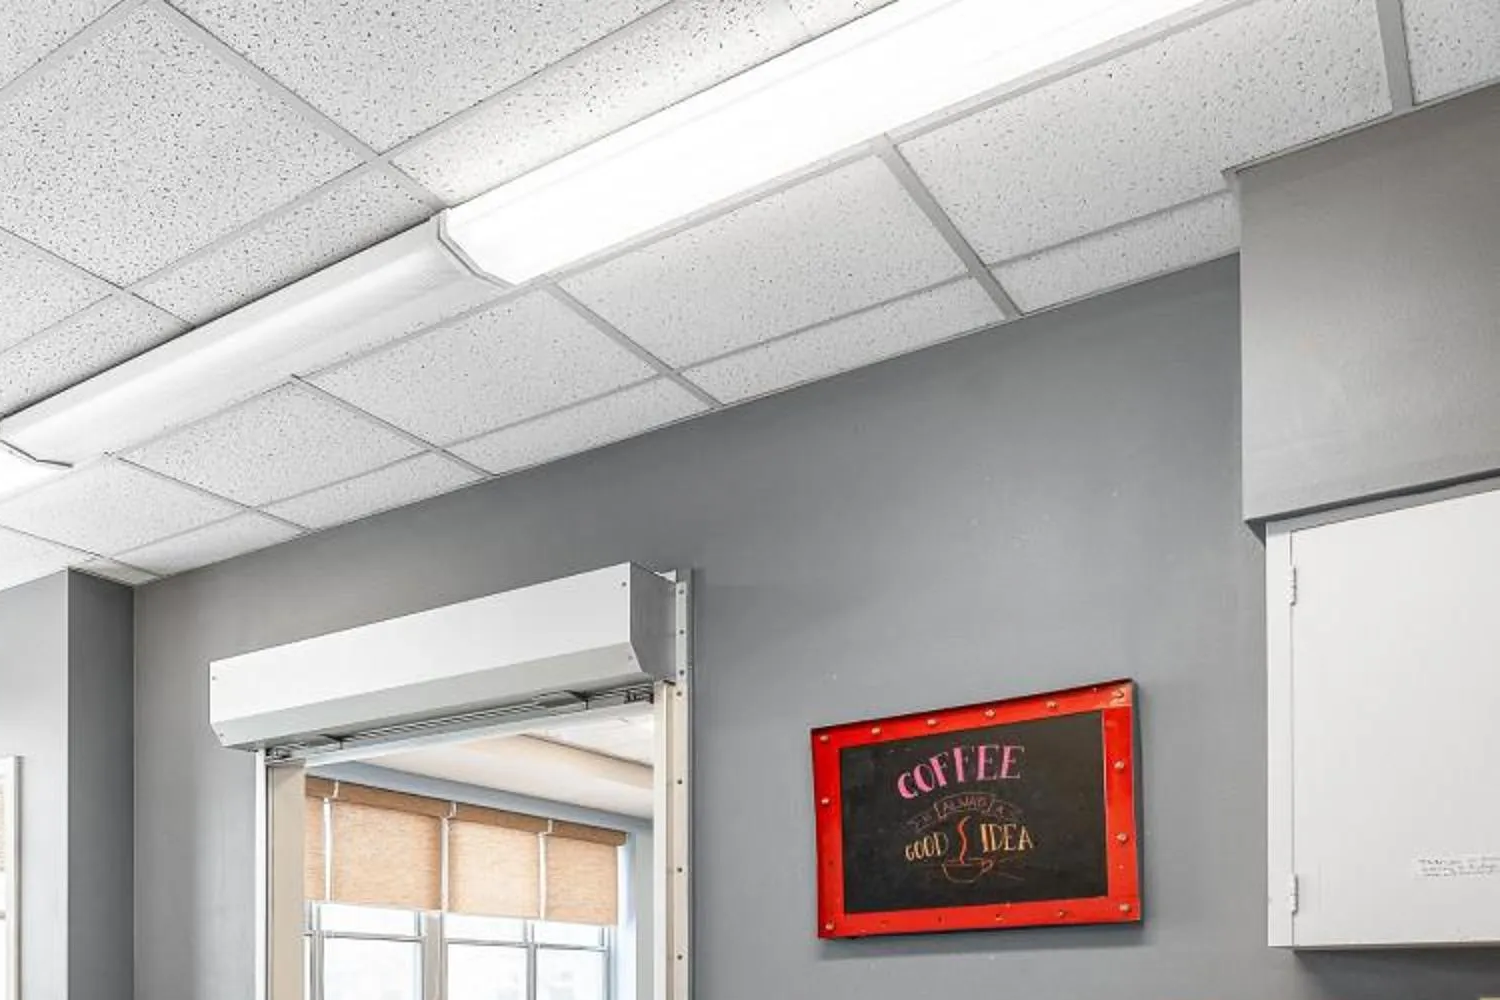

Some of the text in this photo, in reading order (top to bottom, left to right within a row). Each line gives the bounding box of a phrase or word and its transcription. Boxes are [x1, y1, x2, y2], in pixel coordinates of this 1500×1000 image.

[897, 744, 1026, 799] COFFEE
[905, 823, 1034, 861] GOOD IDEA
